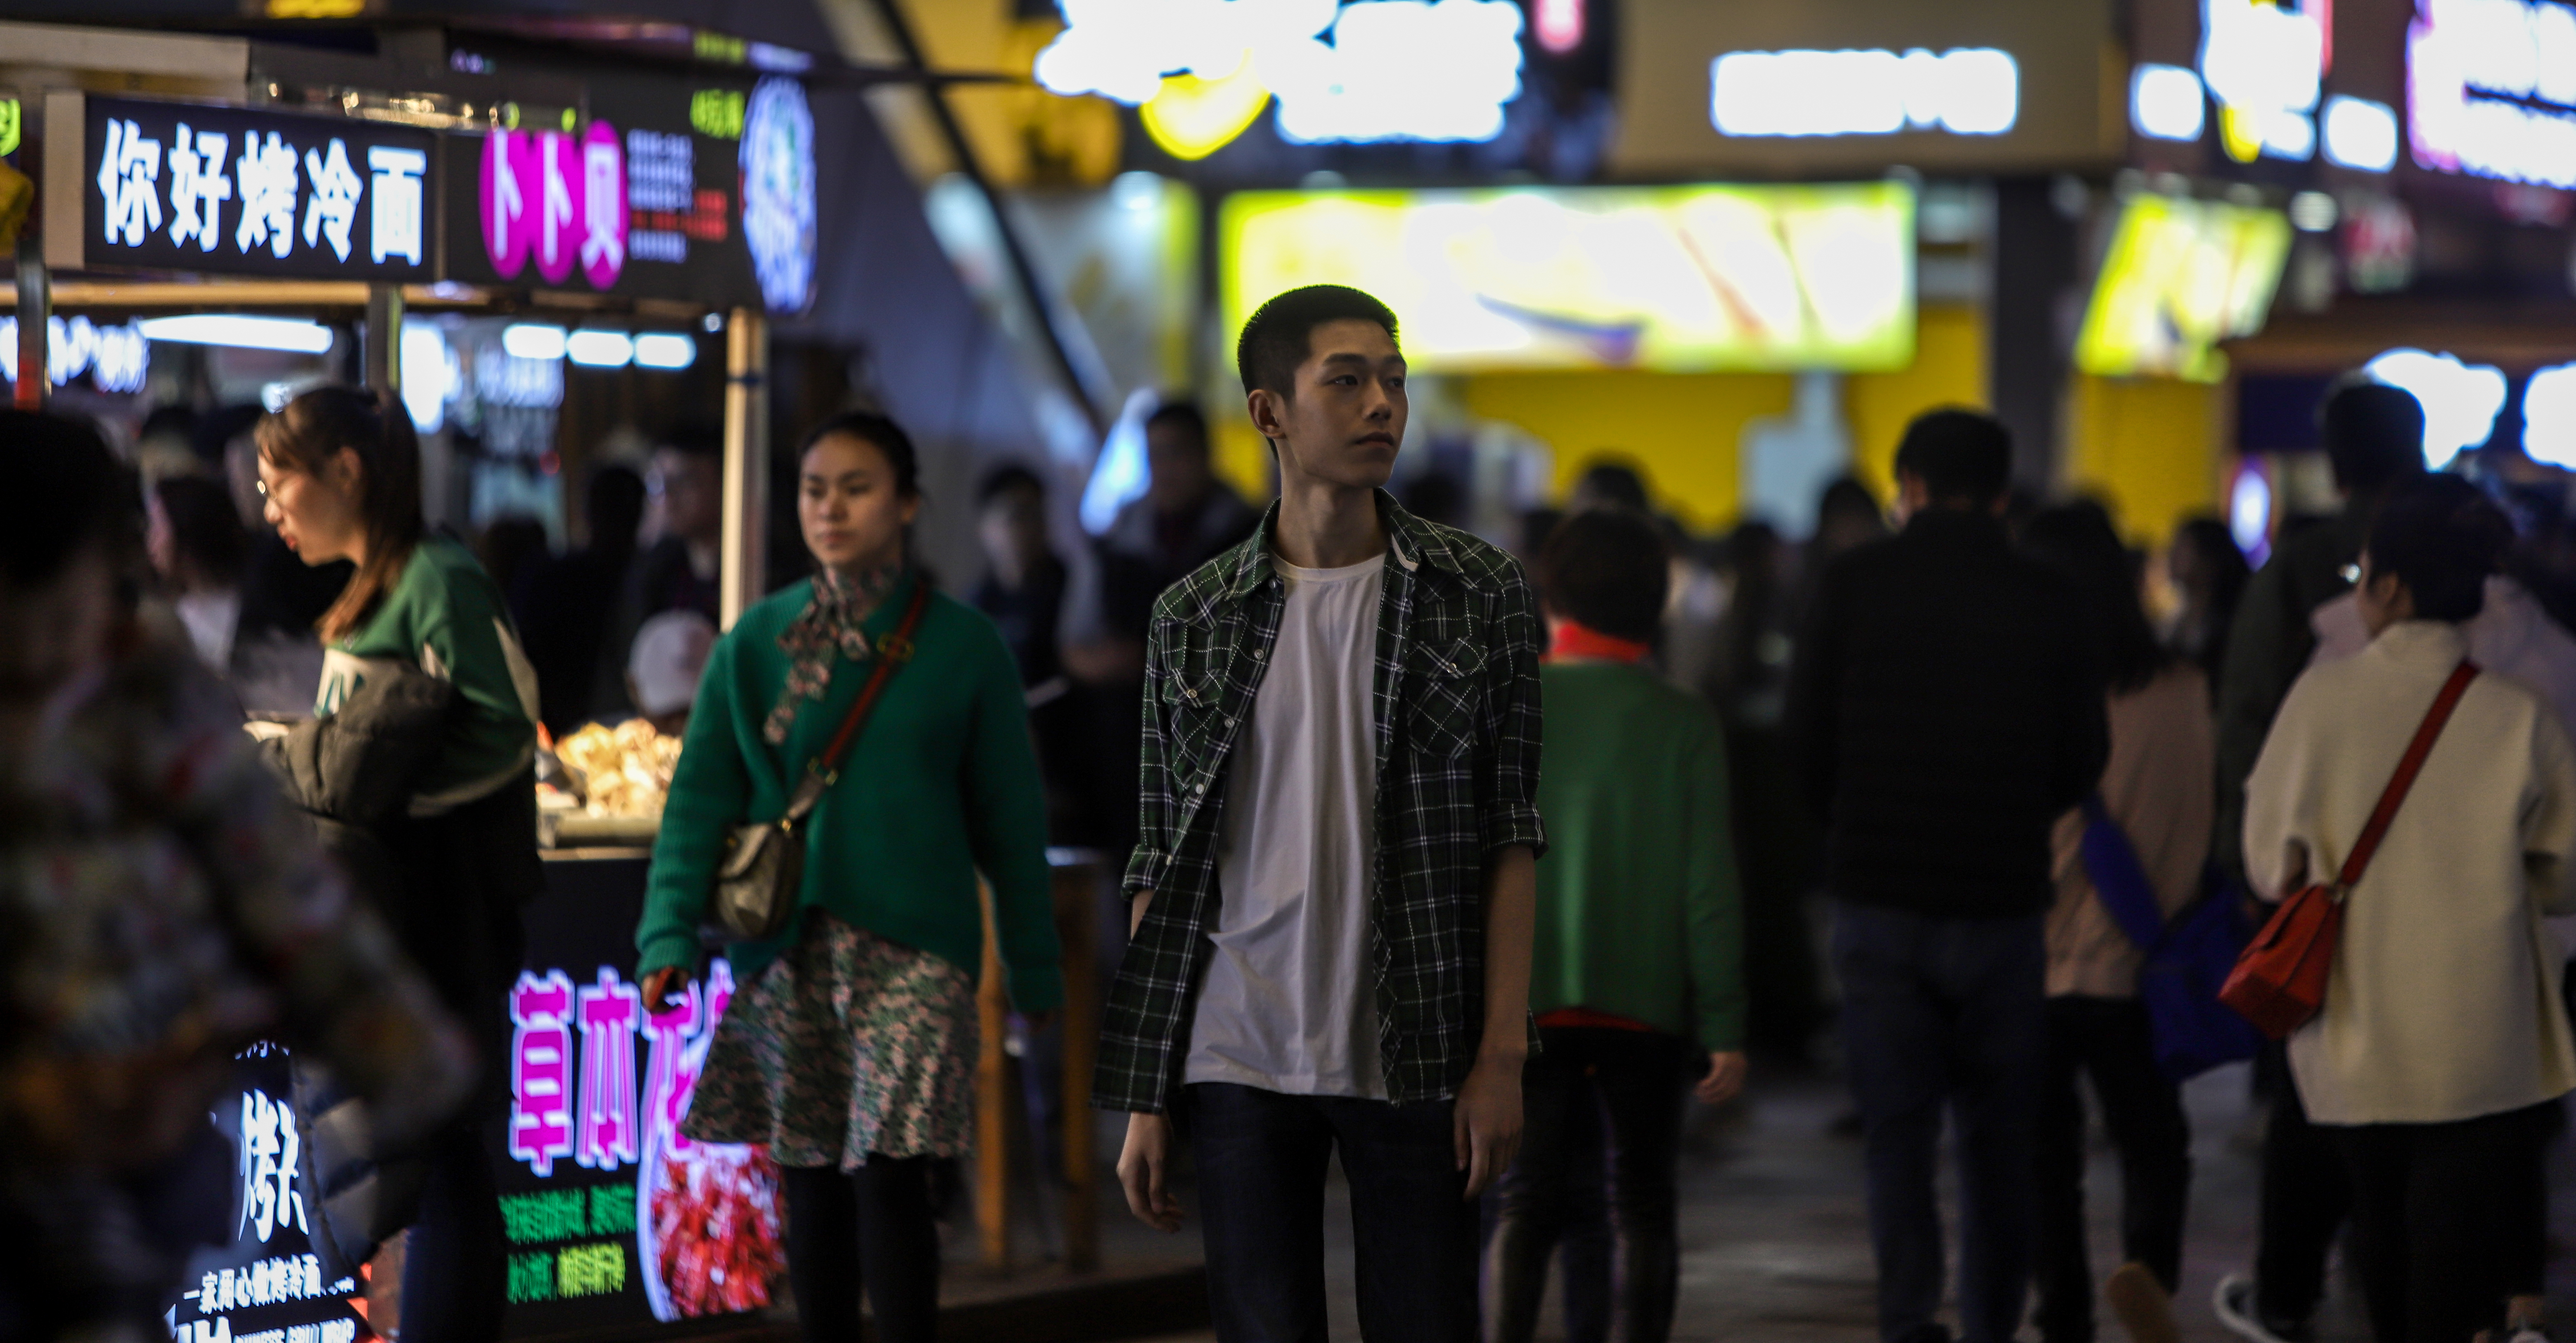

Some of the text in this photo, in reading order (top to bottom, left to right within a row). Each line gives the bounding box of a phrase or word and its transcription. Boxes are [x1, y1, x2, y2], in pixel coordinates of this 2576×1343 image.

[96, 116, 428, 269] 你好烤冷面
[507, 956, 736, 1178] 草本花
[183, 1252, 356, 1315] 一家用心做烤冷面
